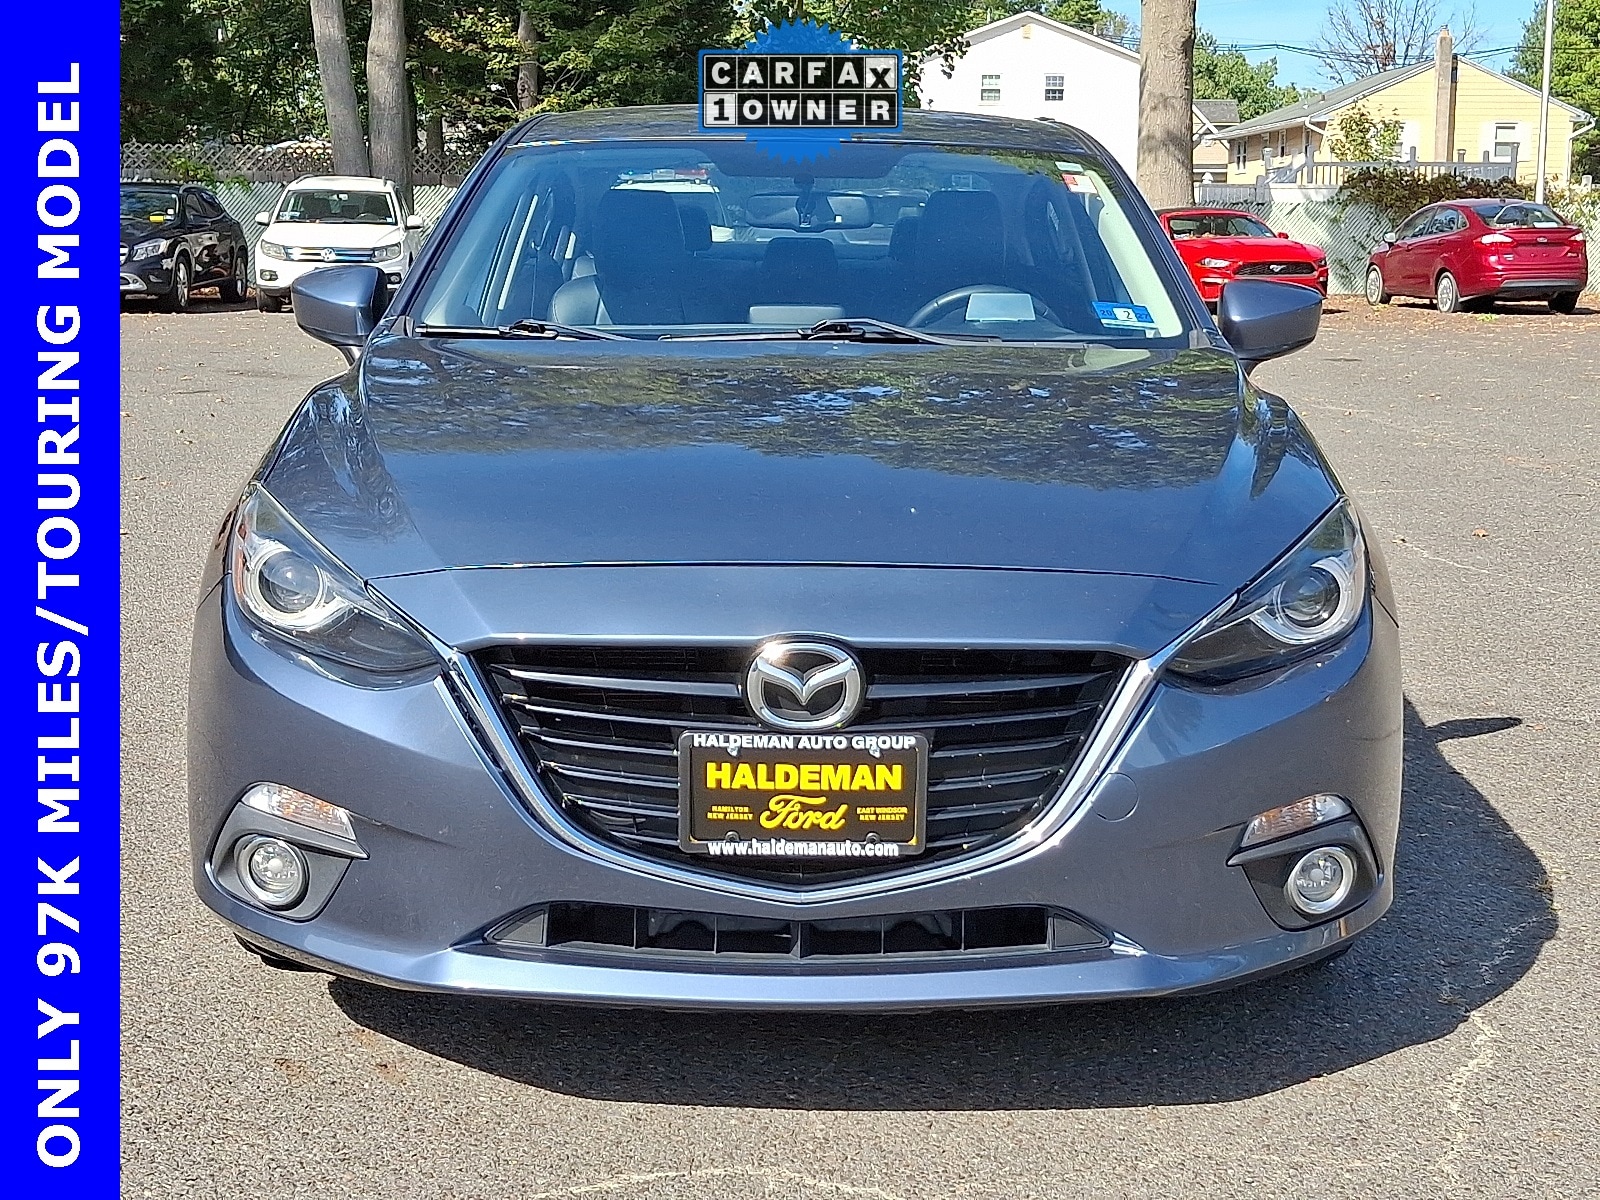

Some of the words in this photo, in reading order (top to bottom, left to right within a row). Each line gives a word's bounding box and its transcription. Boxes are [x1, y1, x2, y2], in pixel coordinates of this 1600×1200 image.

[1122, 310, 1133, 320] 2
[693, 733, 794, 750] HALDEMAN
[797, 735, 848, 750] AUTO
[851, 735, 917, 750] GROUP
[706, 761, 903, 791] HALDEMAN
[711, 805, 750, 813] HAMILTON
[759, 794, 849, 830] Ford
[707, 837, 900, 857] www.haldemanauto.com
